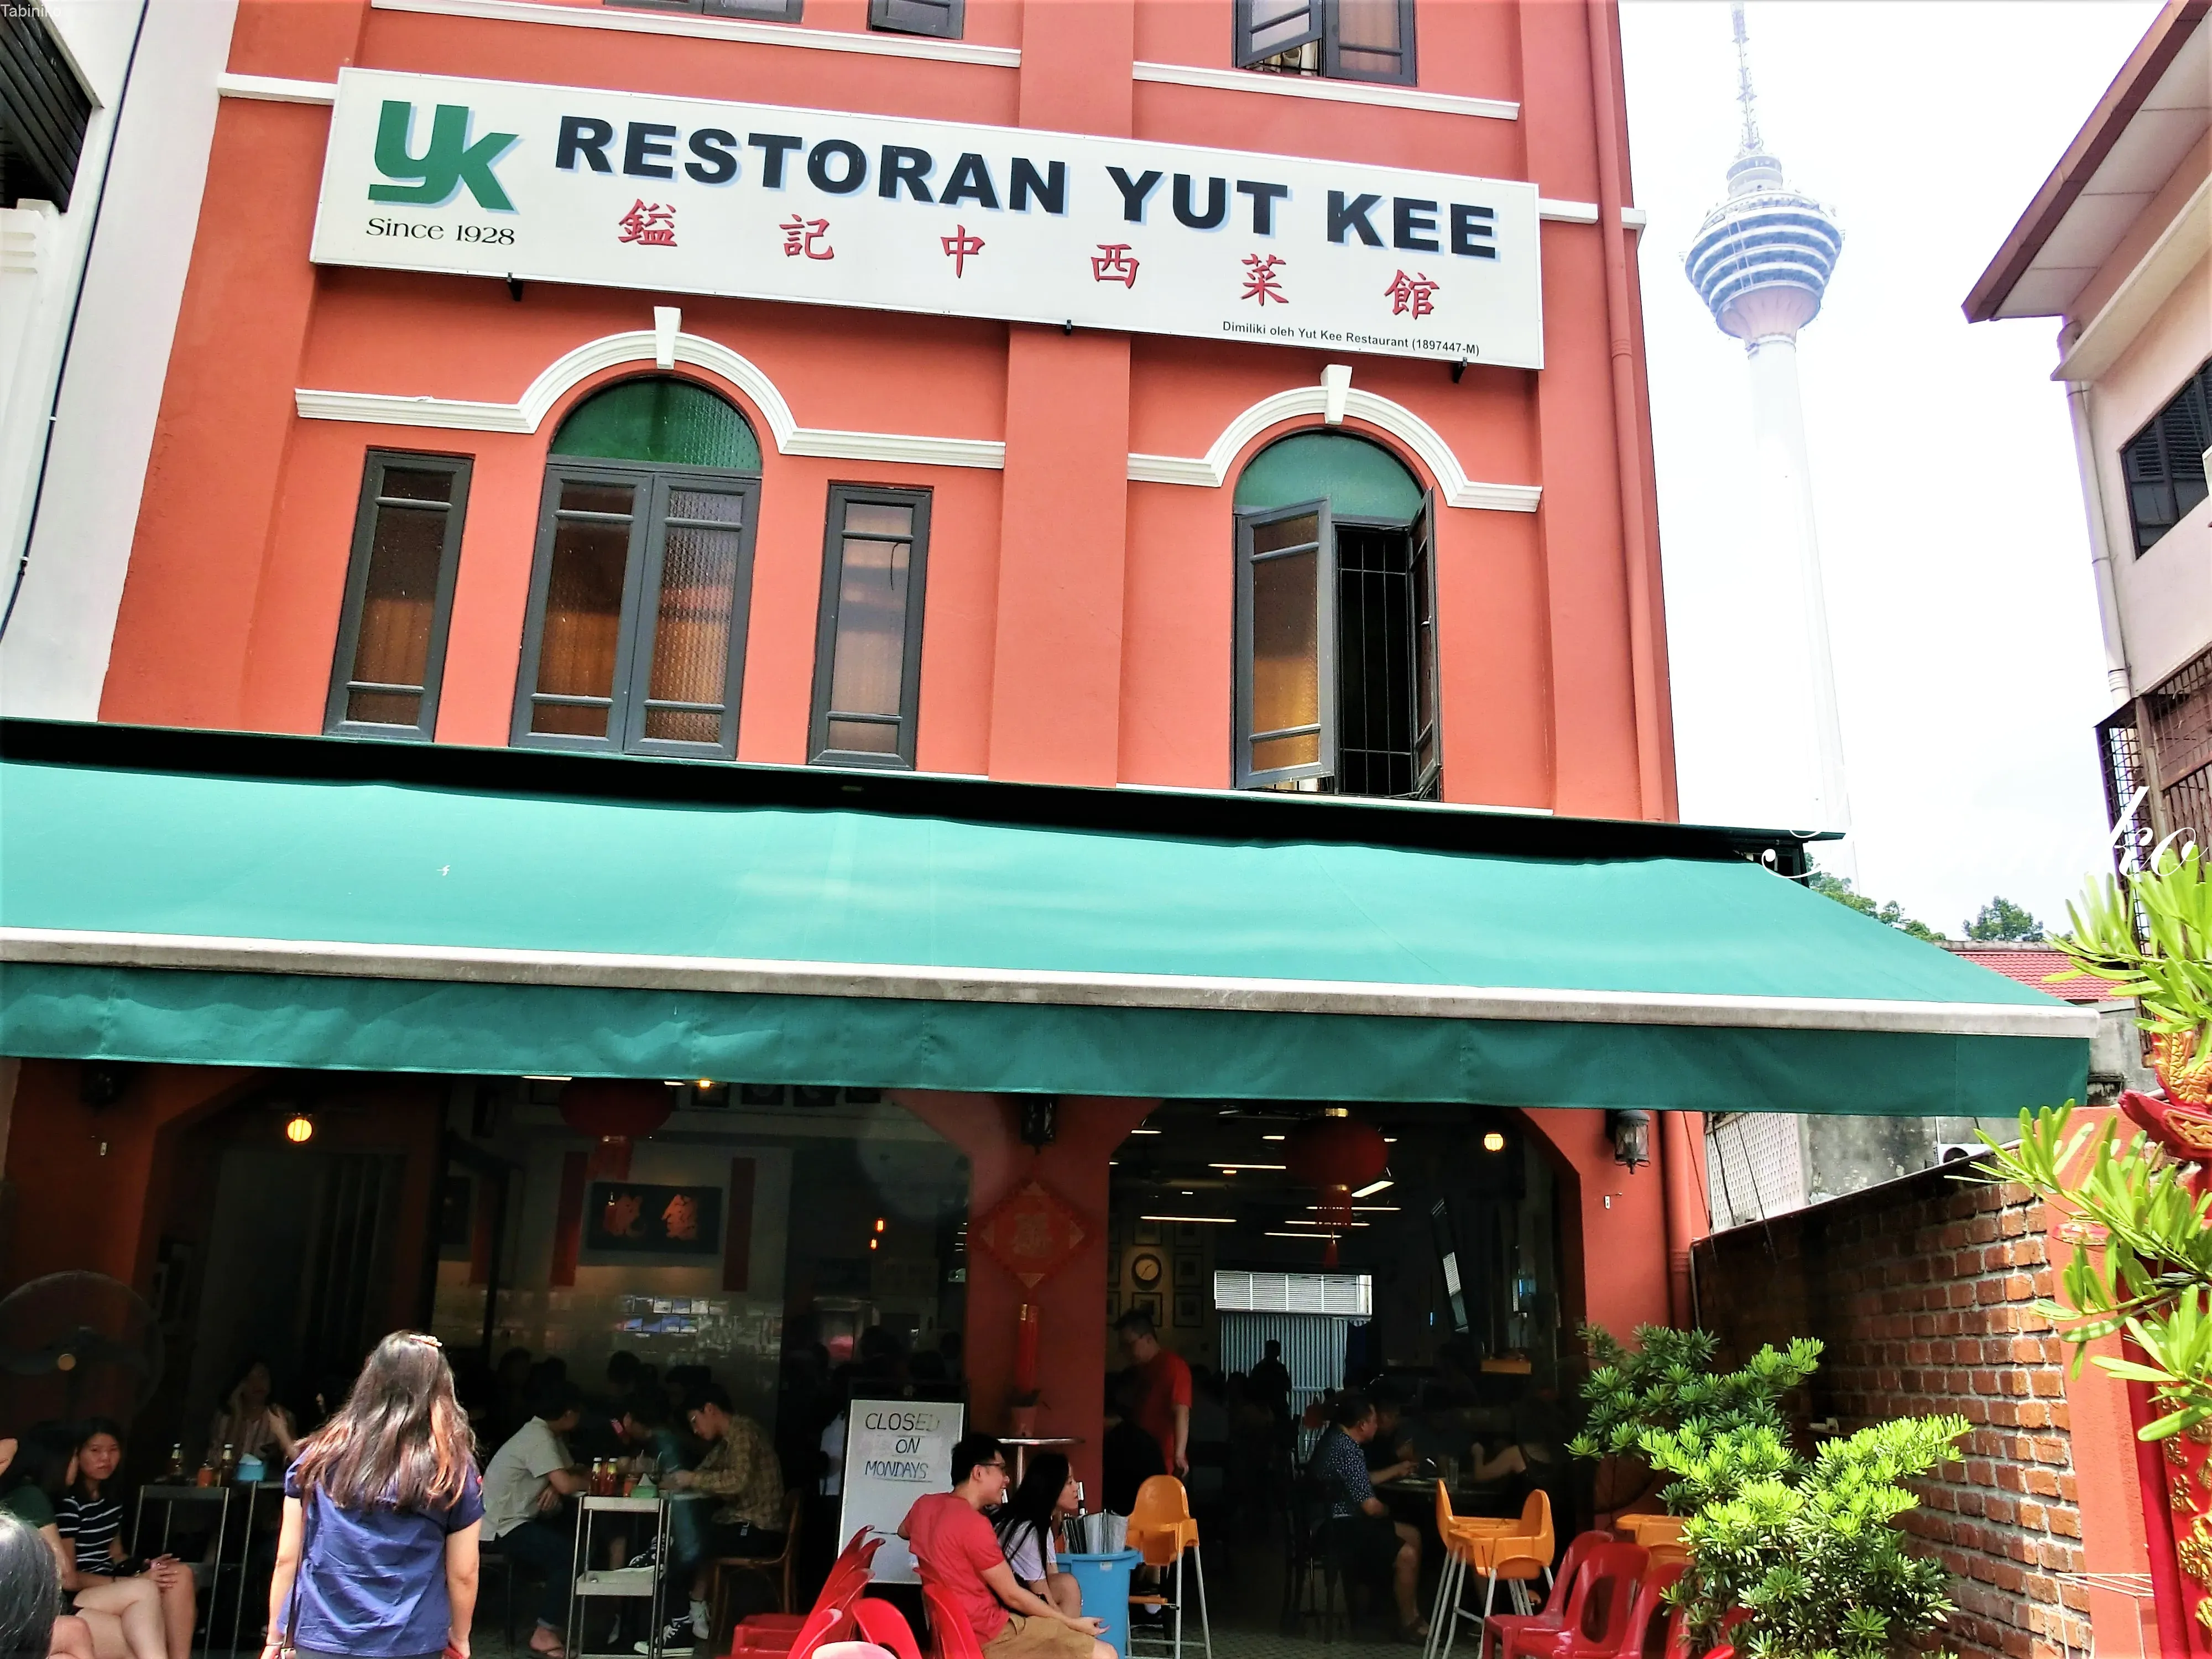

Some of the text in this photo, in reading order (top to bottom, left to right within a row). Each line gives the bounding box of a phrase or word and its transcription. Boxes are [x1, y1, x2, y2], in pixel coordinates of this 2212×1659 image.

[555, 116, 1495, 259] RESTORAN YUT KEE
[366, 218, 515, 245] Since 1928
[1222, 321, 1480, 357] Dimiliki oleh Yut Kee Restaurant (1897447-M)
[865, 1413, 940, 1431] CLOSED
[896, 1438, 920, 1453] ON
[865, 1460, 928, 1479] MONDAYS
